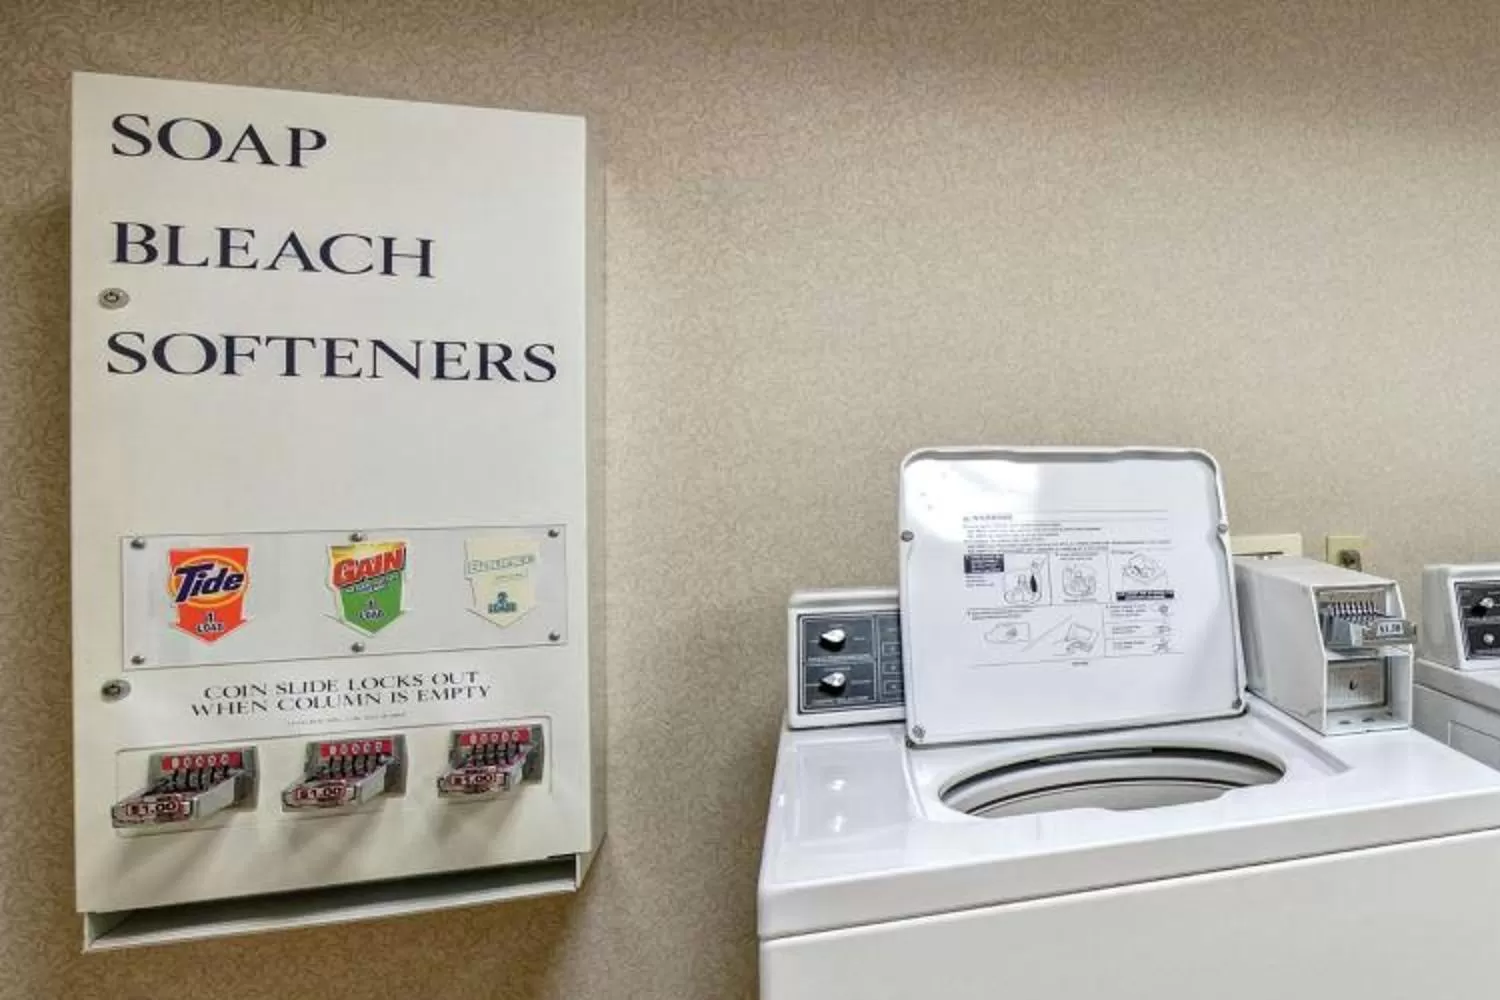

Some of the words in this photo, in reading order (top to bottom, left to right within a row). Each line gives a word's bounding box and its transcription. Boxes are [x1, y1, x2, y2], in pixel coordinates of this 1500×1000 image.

[111, 113, 328, 168] SOAP
[110, 221, 436, 279] BLEACH
[107, 331, 558, 383] SOFTENERS
[175, 562, 245, 603] Tide
[332, 543, 407, 589] GAIN
[206, 611, 214, 624] 1
[191, 700, 268, 716] WHEN
[277, 693, 382, 711] COLUMN
[391, 691, 410, 704] IS
[417, 685, 491, 703] EMPTY
[203, 682, 267, 699] COIN
[275, 679, 341, 695] SLIDE
[348, 674, 423, 691] LOCKS
[431, 671, 479, 685] OUT
